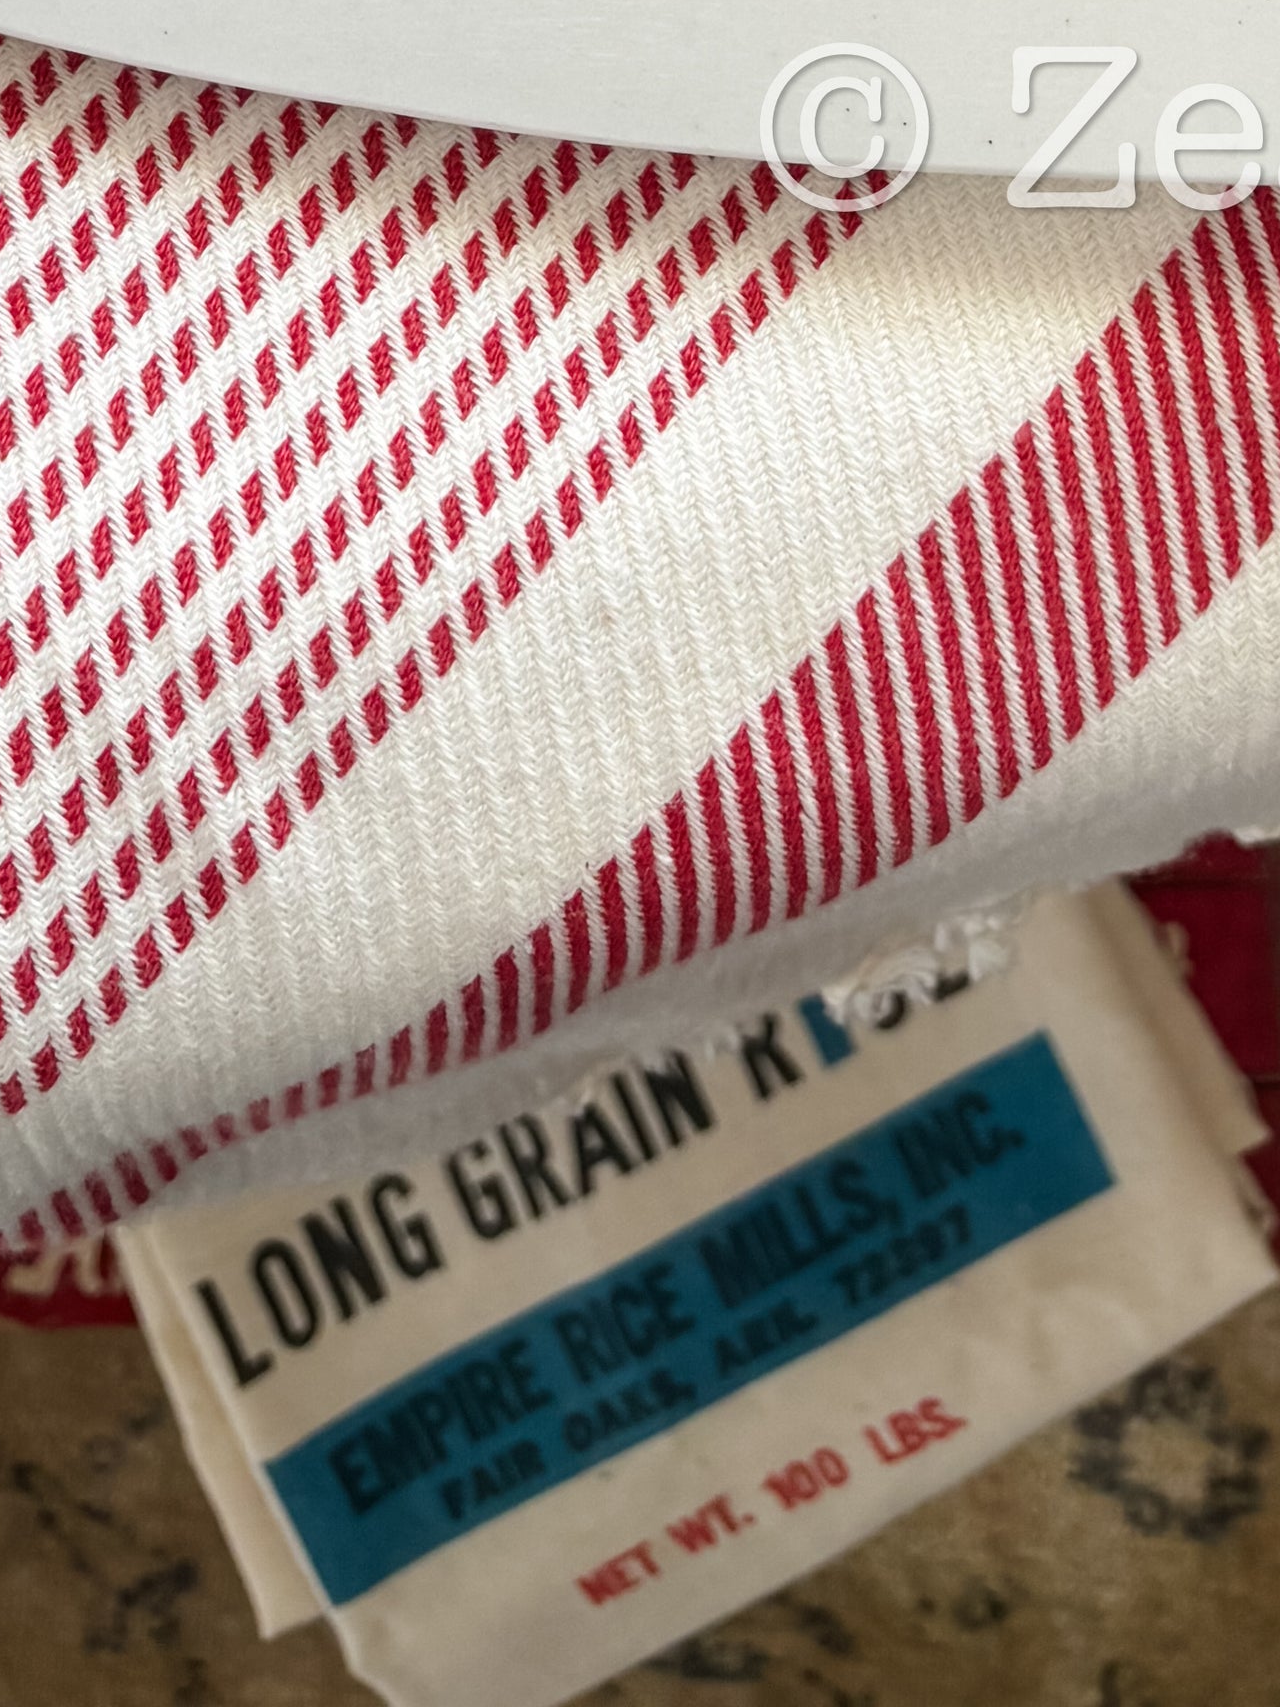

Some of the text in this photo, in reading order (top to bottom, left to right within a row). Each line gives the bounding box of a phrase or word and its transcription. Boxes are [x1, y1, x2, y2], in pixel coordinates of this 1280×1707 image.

[195, 1171, 446, 1388] LONG
[443, 1050, 717, 1243] GRAIN
[327, 1089, 1025, 1516] EMPIRE RICE MILLS, INC.
[439, 1441, 547, 1521] FAIR
[576, 1396, 968, 1604] NET WT. 100 LBS.
